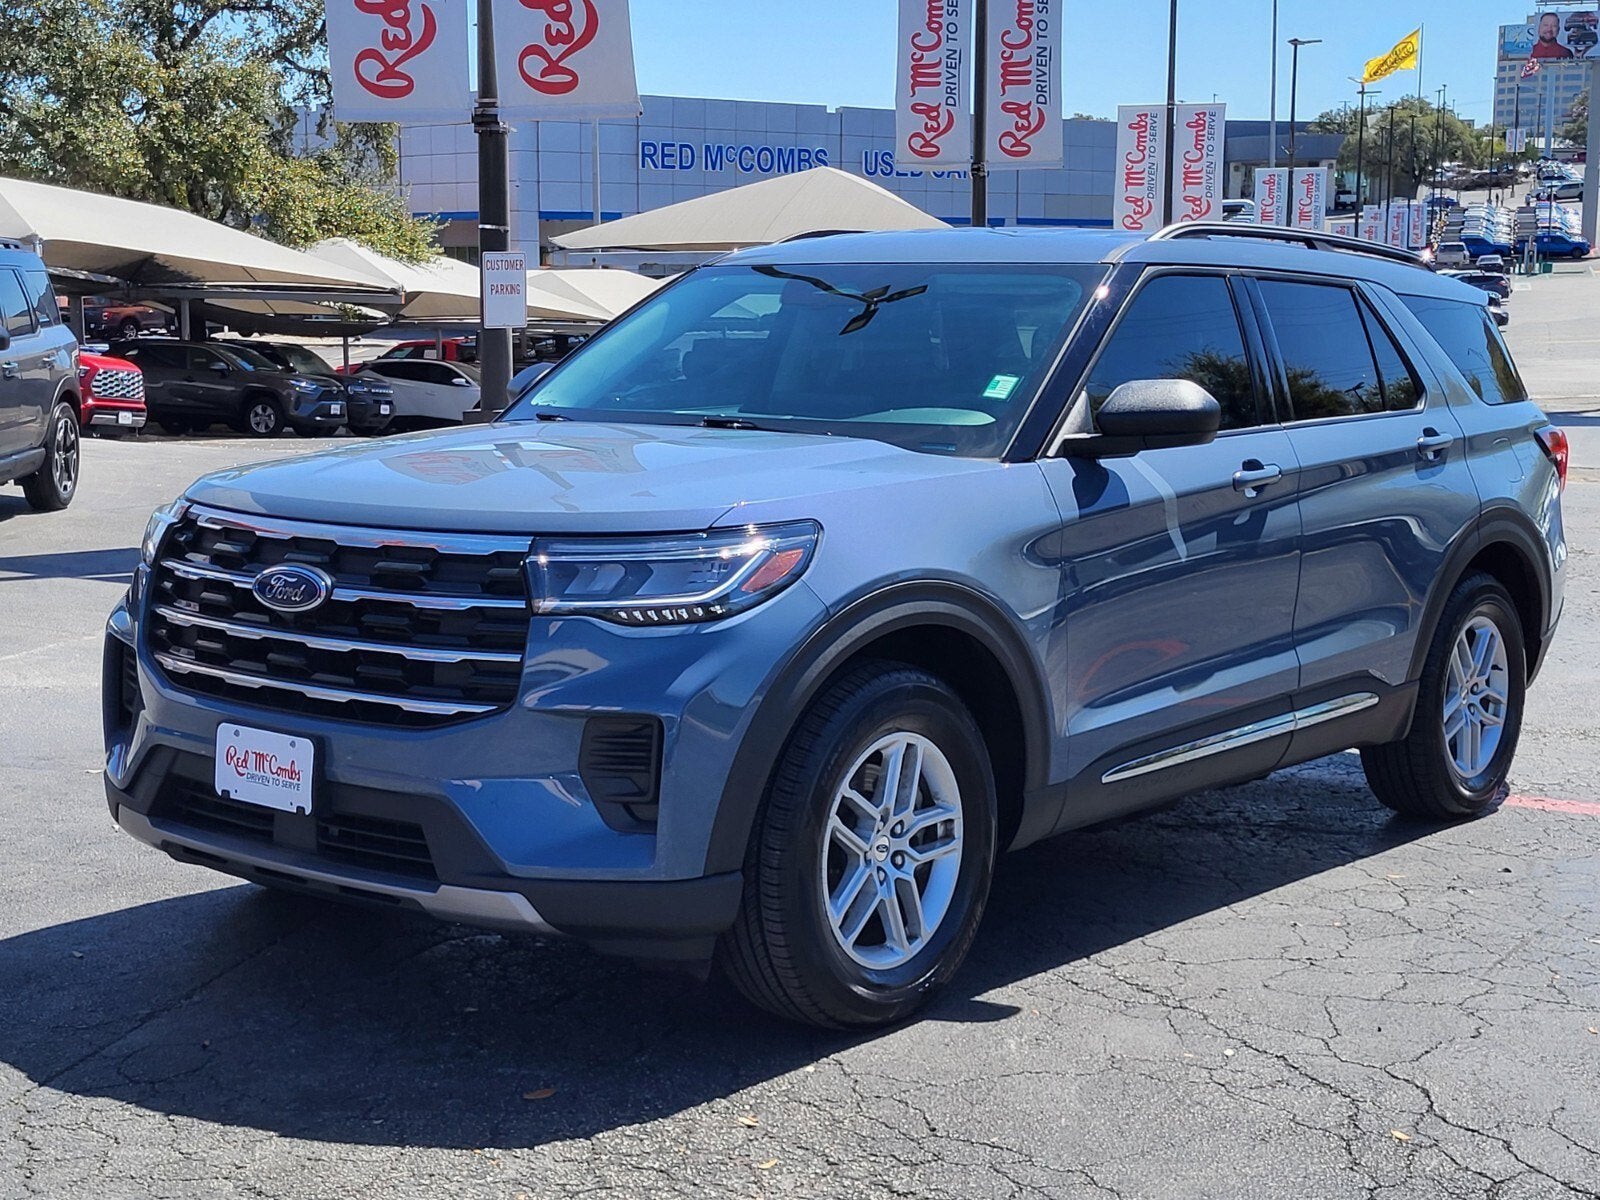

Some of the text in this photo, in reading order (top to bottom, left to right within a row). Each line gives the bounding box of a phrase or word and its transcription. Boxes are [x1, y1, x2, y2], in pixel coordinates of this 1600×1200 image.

[946, 22, 958, 43] TO
[1037, 19, 1049, 41] TO
[945, 48, 957, 107] DRIVEN
[1036, 45, 1048, 105] DRIVEN
[908, 102, 955, 158] Red
[998, 101, 1046, 157] Red
[1182, 111, 1206, 192] McCombs
[641, 141, 696, 170] RED
[1122, 112, 1152, 230] Red McCombs
[1147, 112, 1158, 199] DRIVEN TO SERVE
[1206, 111, 1216, 198] DRIVEN TO SERVE
[486, 259, 524, 271] CUSTOMER
[490, 284, 520, 295] PARKING
[266, 574, 306, 601] Ford
[226, 745, 301, 781] Red McCombs
[246, 772, 301, 791] DRIVEN TO SERVE
